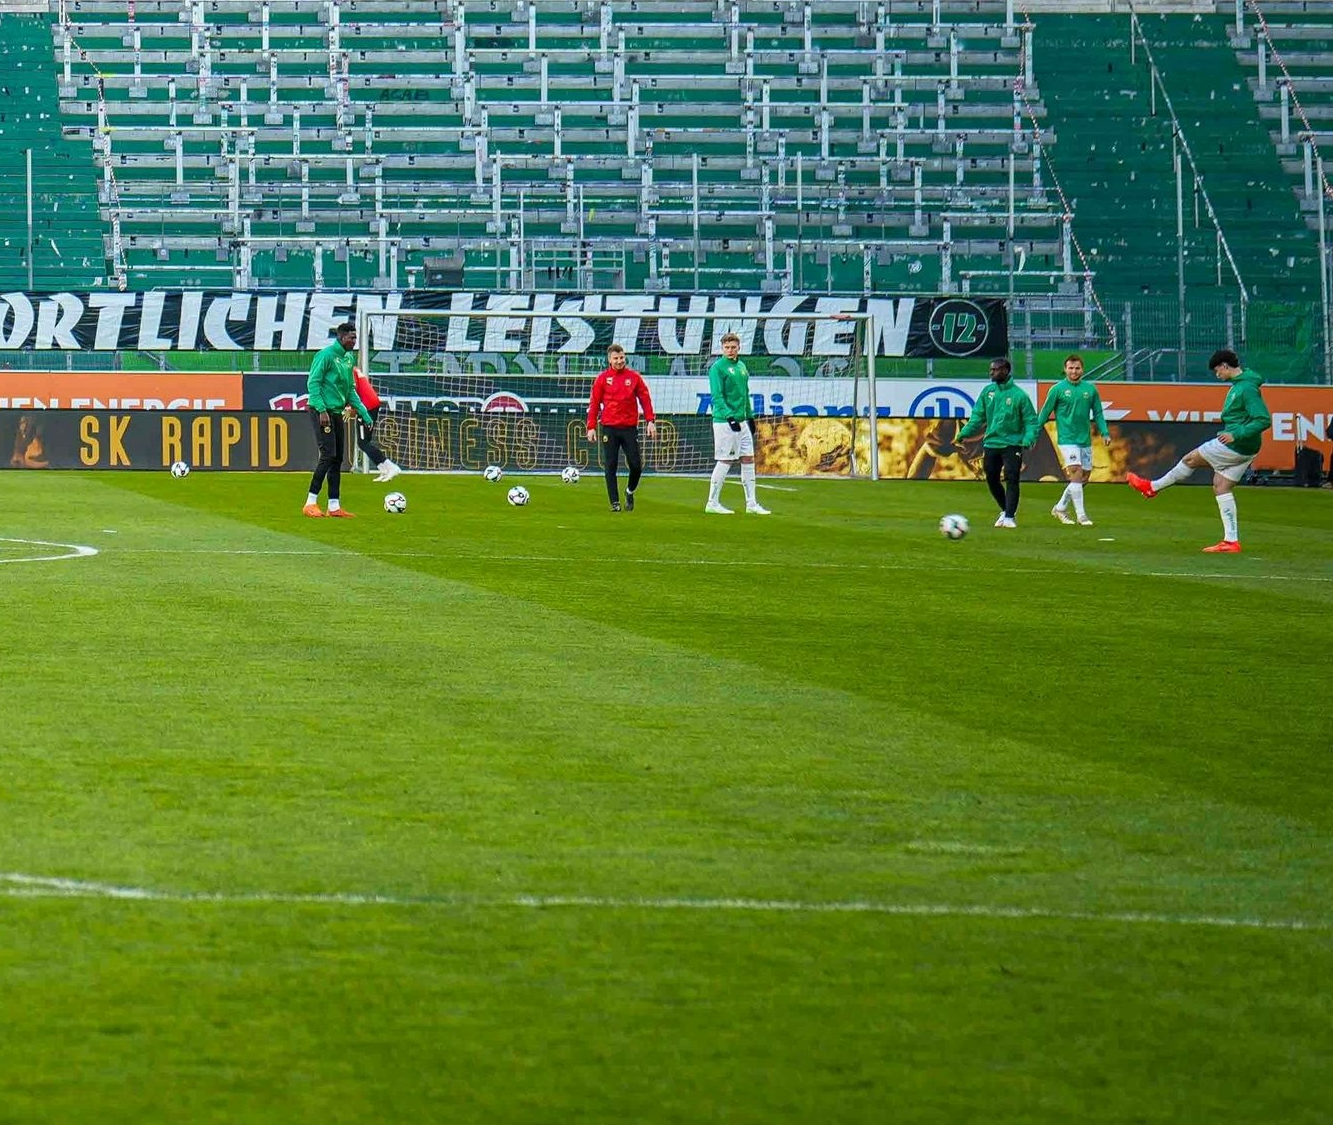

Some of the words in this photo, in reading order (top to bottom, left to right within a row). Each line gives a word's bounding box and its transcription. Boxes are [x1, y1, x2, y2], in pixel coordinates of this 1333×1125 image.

[449, 292, 916, 357] LEISTUNGEN
[79, 415, 131, 466] SK
[162, 416, 289, 467] RAPID
